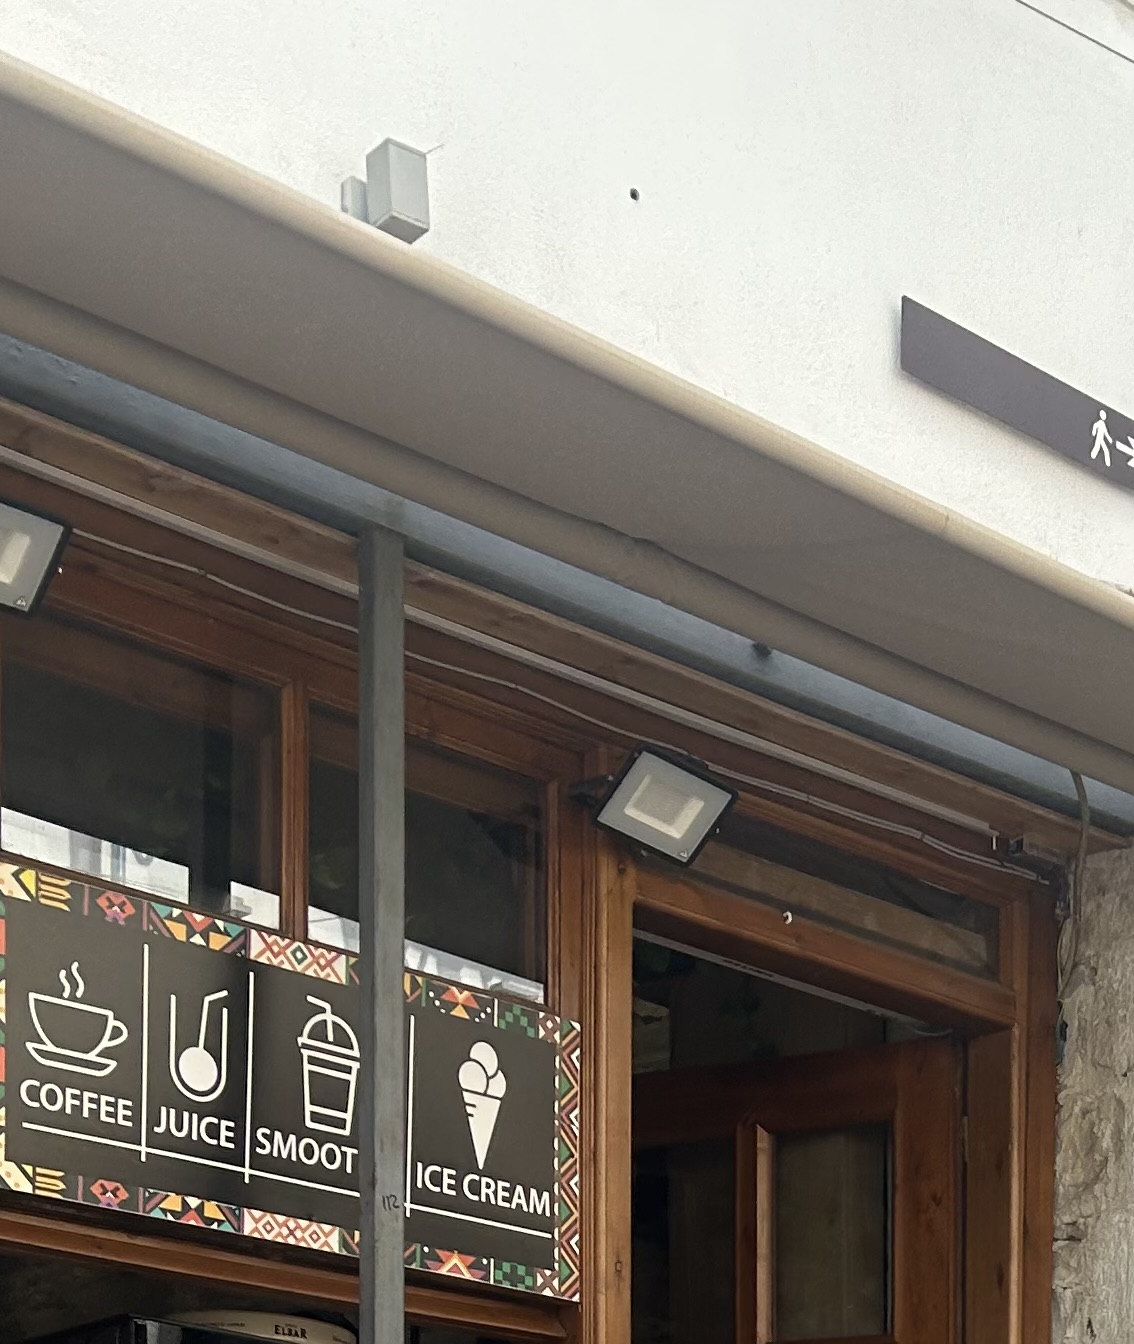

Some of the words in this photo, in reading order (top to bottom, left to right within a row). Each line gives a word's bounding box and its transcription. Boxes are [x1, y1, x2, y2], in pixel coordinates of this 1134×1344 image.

[19, 1079, 133, 1128] COFFEE
[153, 1105, 236, 1149] JUICE
[255, 1128, 359, 1174] SMOOT
[416, 1162, 456, 1196] ICE
[463, 1174, 551, 1218] CREAM
